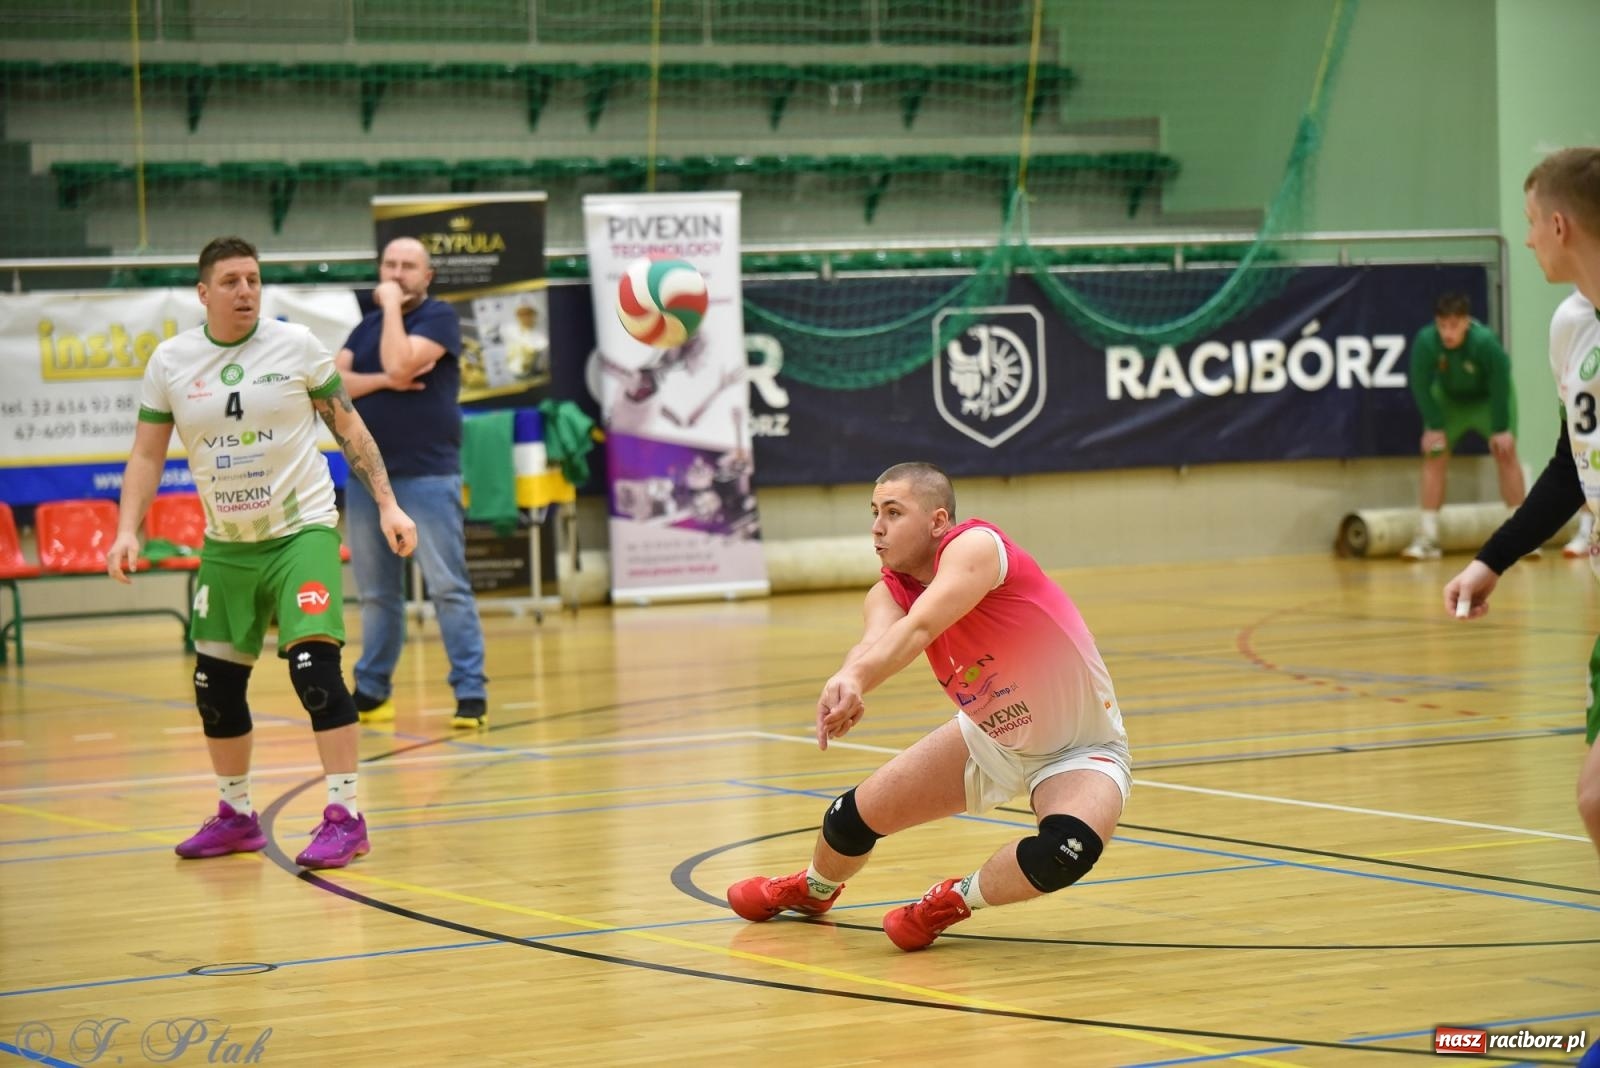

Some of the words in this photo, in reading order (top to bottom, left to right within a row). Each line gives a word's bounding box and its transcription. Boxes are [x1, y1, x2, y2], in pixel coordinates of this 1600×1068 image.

[608, 214, 722, 239] PIVEXIN
[1105, 319, 1408, 400] RACIBÓRZ
[225, 391, 244, 421] 4
[1574, 391, 1597, 434] 3
[203, 429, 273, 448] VISON
[215, 485, 272, 504] PIVEXIN
[216, 499, 272, 513] TECHNOLOGY
[193, 584, 209, 618] 4
[978, 700, 1030, 733] IVEXIN
[988, 714, 1033, 739] CHNOLOGY
